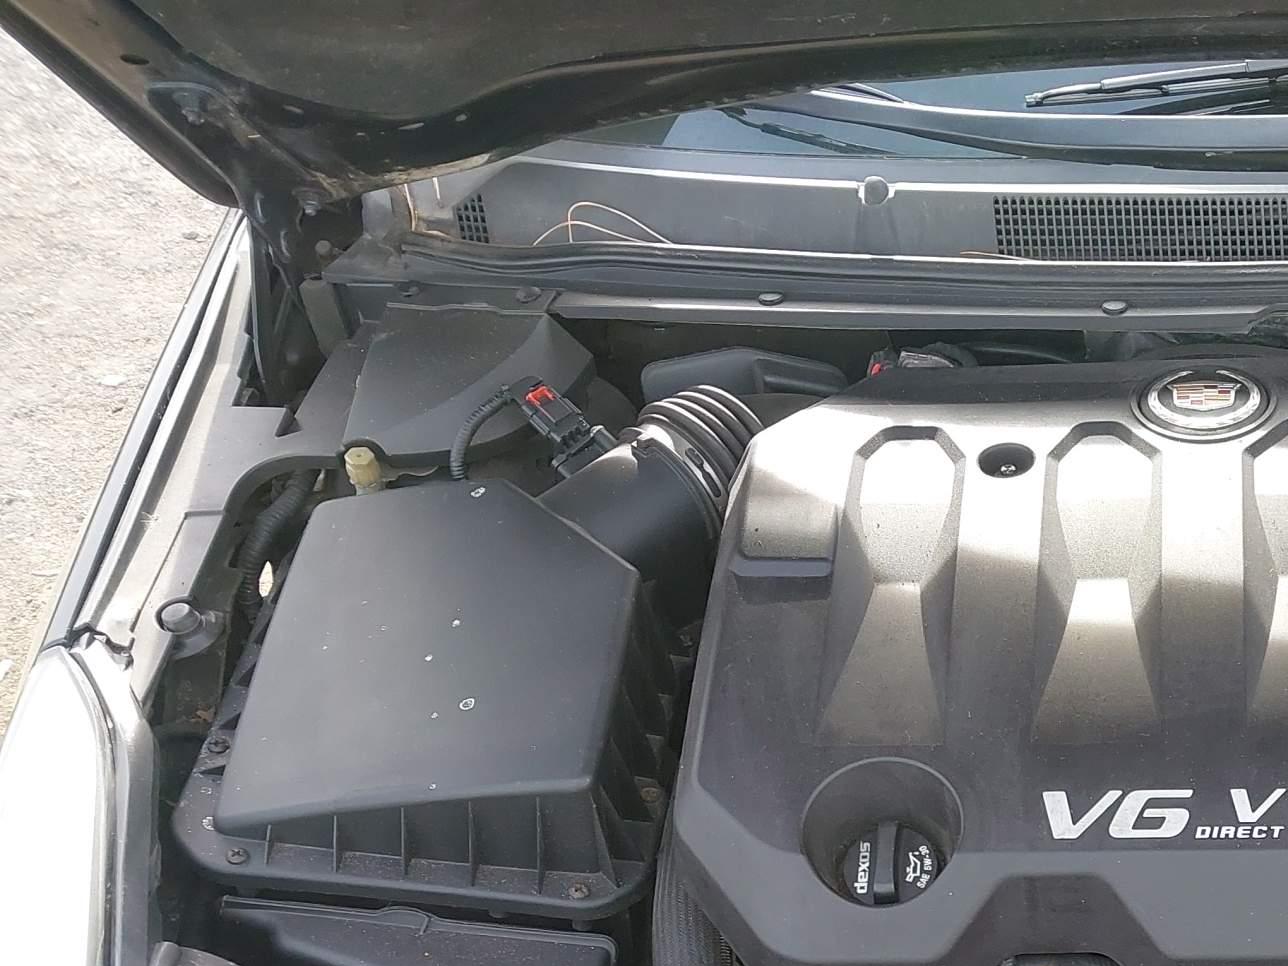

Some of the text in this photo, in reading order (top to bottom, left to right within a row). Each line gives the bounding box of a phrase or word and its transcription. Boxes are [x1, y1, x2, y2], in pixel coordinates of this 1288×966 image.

[1042, 789, 1194, 839] V6
[1195, 826, 1284, 839] DIRECT
[854, 841, 871, 894] dexos
[917, 873, 931, 889] SAE
